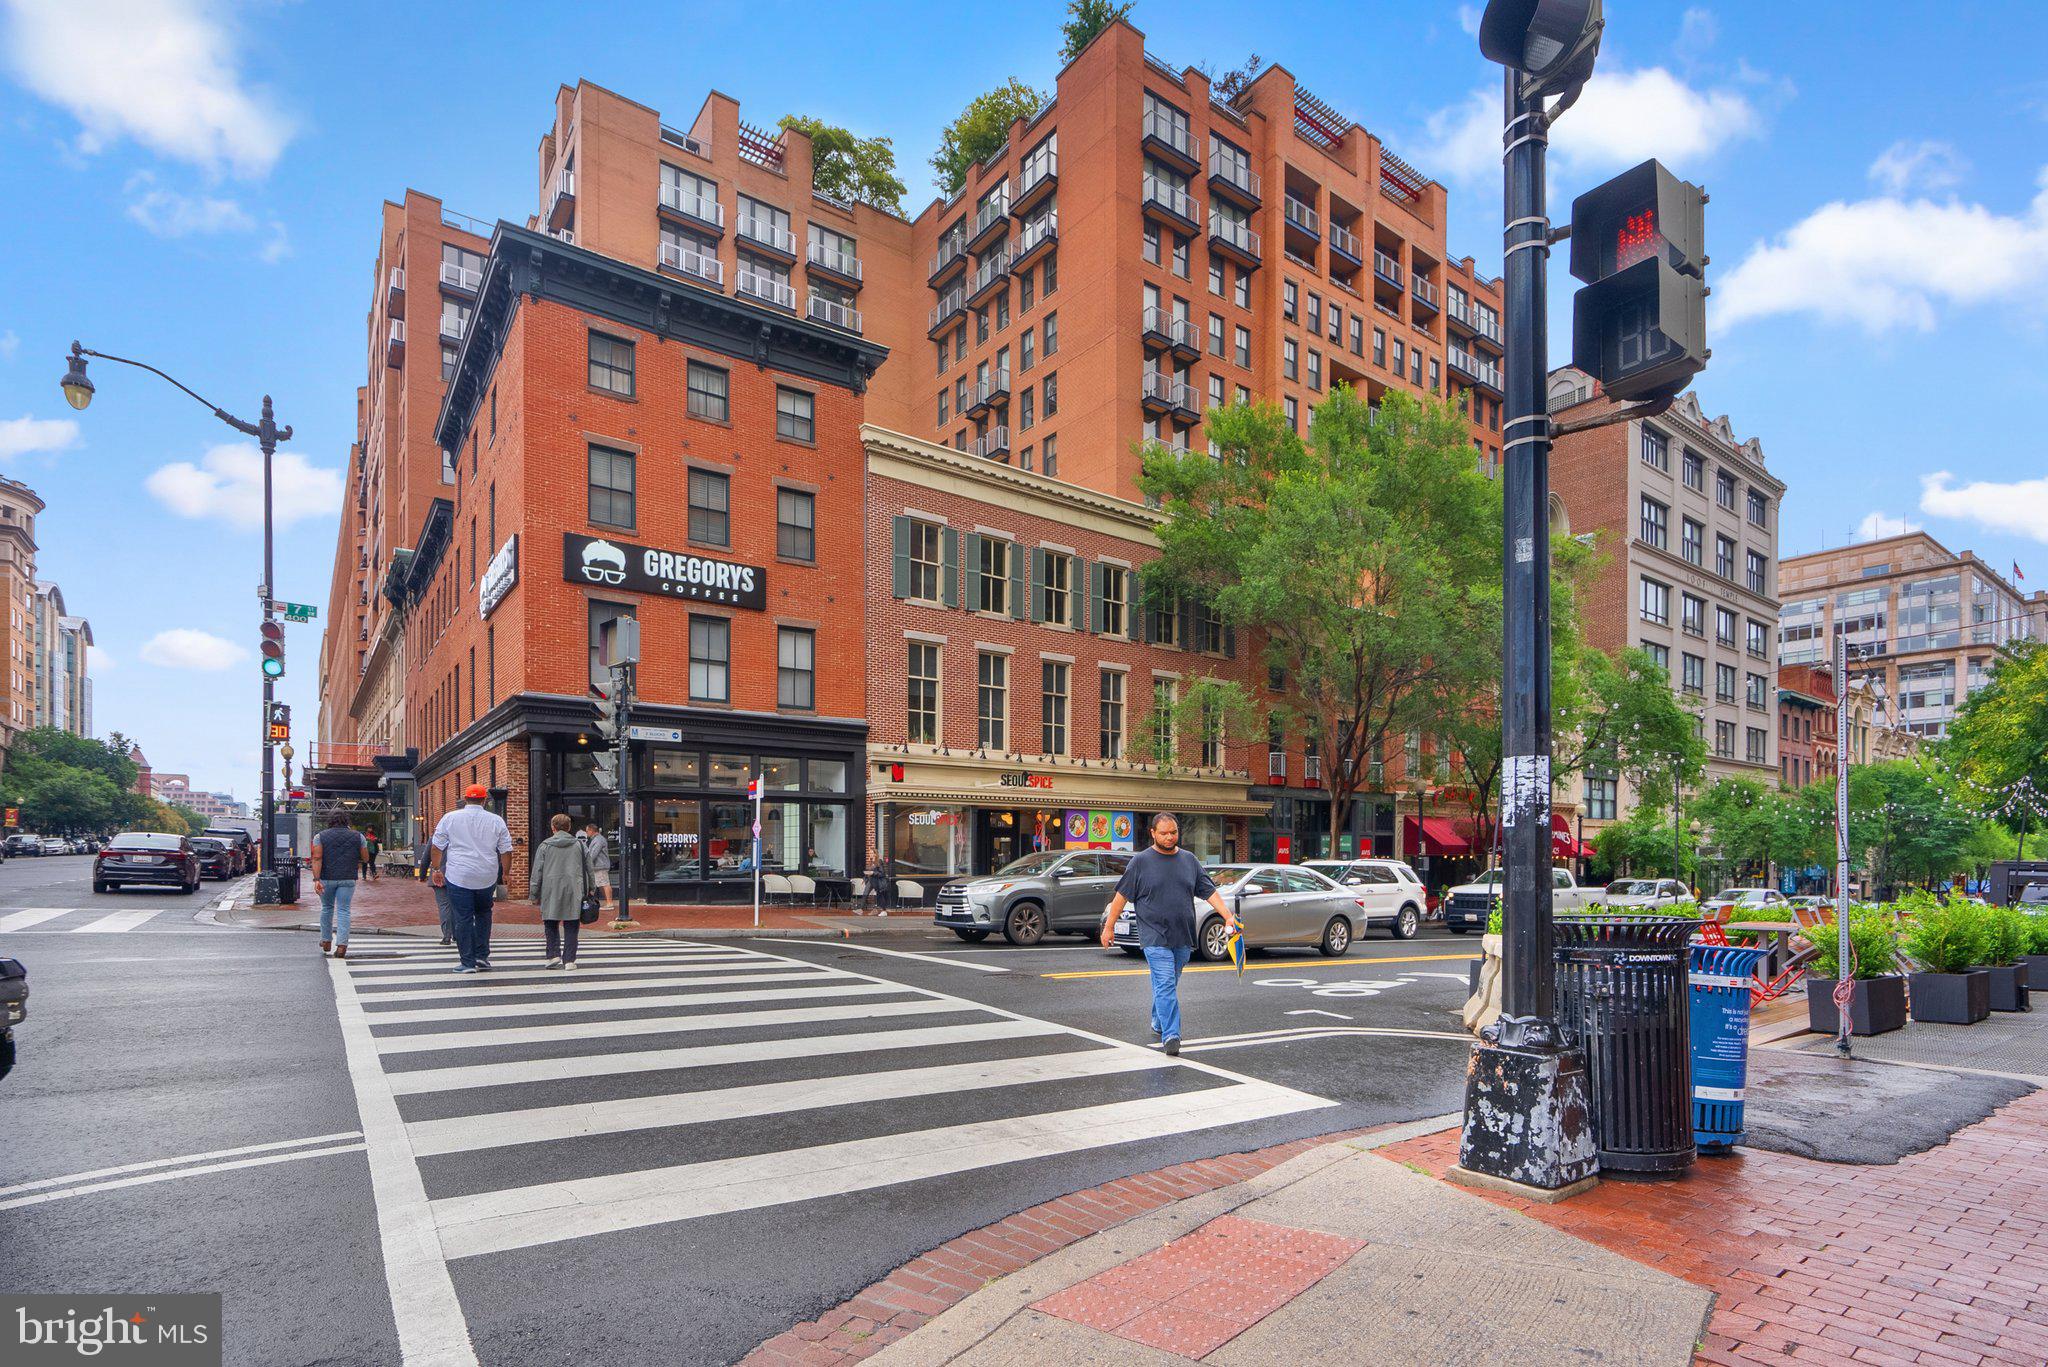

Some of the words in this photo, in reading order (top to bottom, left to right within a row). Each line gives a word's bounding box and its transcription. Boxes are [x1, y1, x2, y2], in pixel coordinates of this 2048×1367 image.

[644, 550, 754, 592] GREGORYS
[662, 583, 739, 602] COFFEE
[1720, 587, 1738, 602] TEMPLE
[294, 605, 302, 614] 7
[286, 614, 306, 622] 400
[271, 726, 288, 738] 30
[656, 833, 698, 844] GREGORYS
